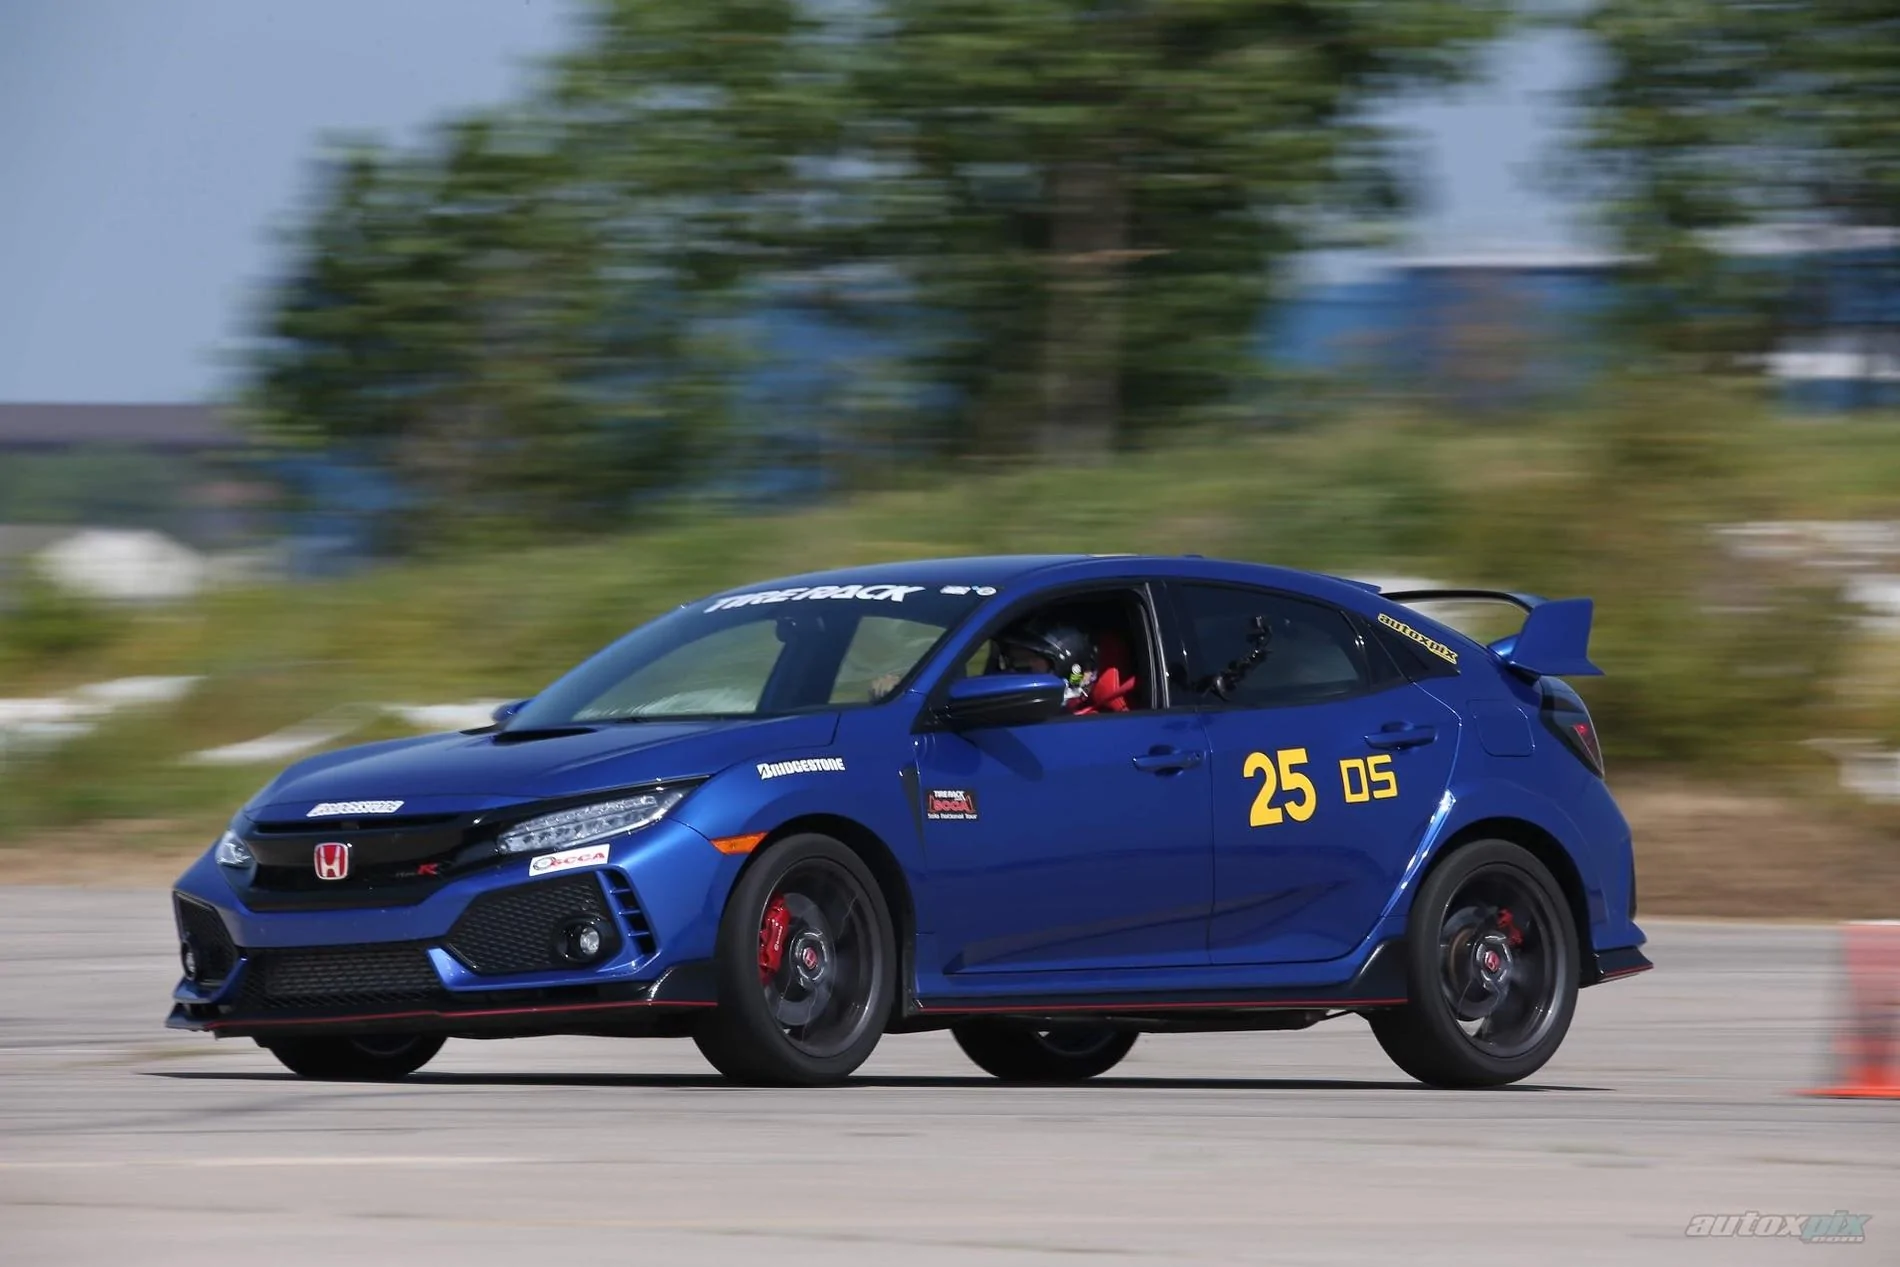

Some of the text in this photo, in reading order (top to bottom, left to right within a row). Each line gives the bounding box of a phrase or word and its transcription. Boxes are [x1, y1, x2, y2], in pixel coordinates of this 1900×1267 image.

[1378, 613, 1458, 663] autoxpix
[756, 757, 846, 780] BRIDGESTONE
[1243, 747, 1317, 827] 25
[1339, 754, 1398, 804] DS
